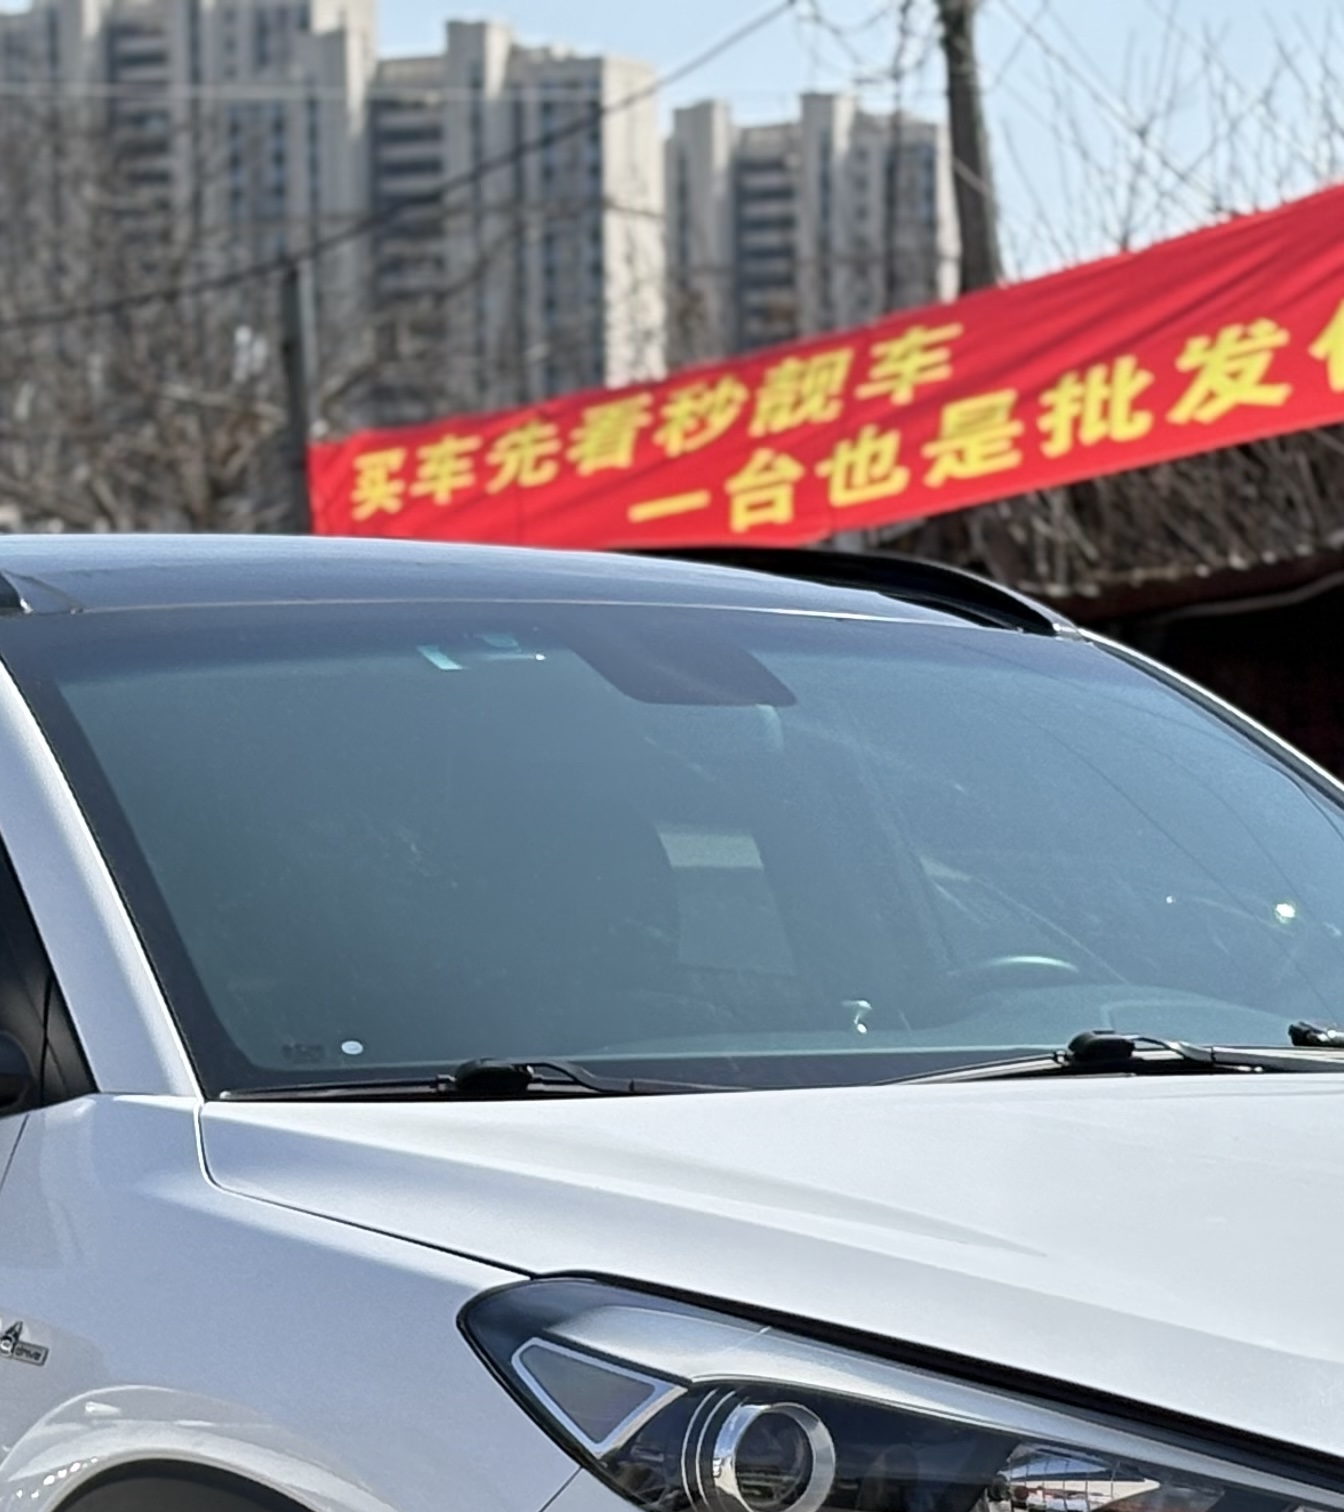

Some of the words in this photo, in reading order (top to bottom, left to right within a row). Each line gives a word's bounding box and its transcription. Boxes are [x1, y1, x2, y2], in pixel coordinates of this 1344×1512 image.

[352, 324, 963, 520] 买车先看秒靓车
